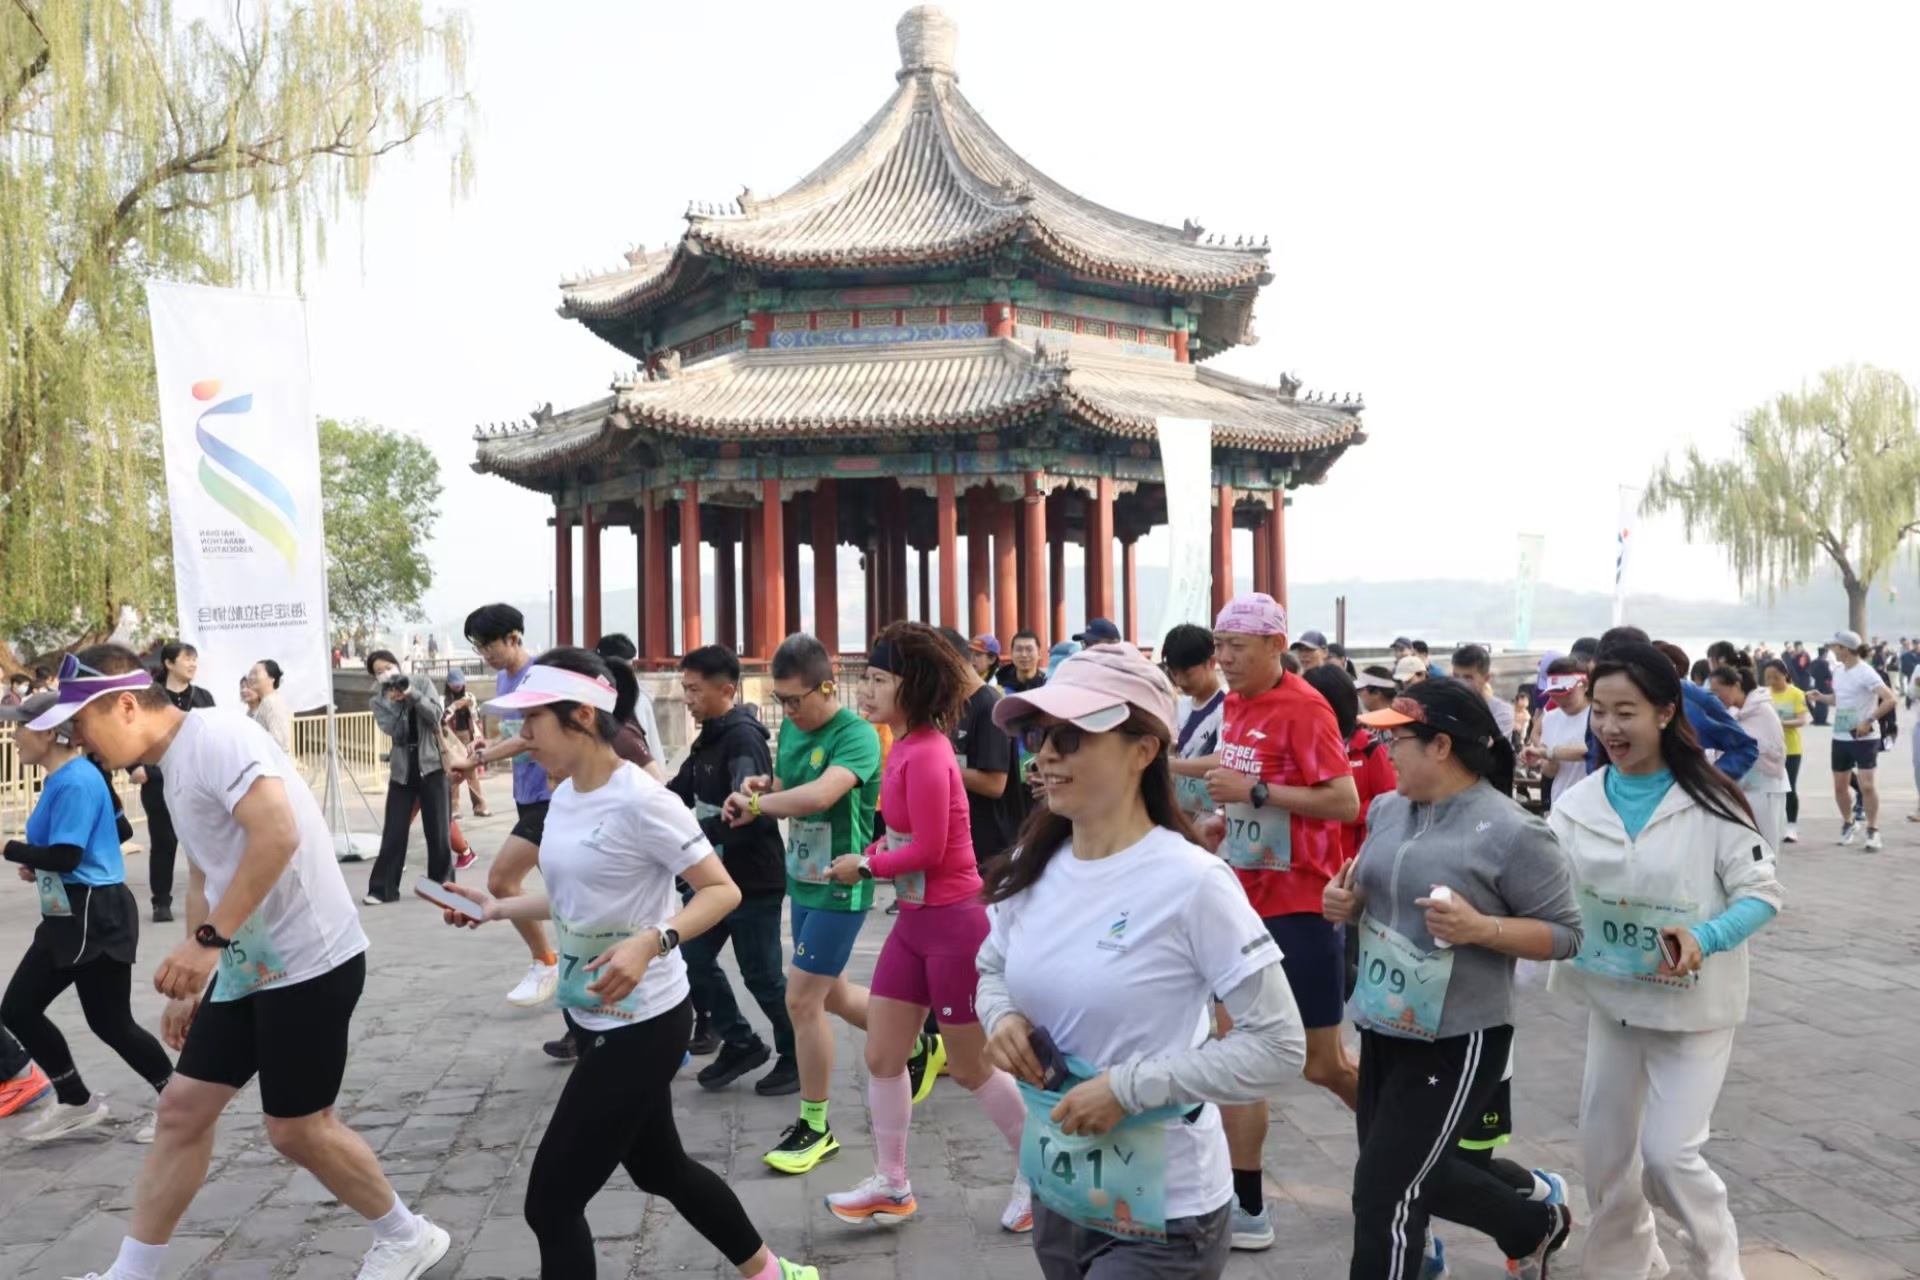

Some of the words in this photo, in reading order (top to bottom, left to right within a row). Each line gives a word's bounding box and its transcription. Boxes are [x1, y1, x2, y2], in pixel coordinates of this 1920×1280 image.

[1221, 742, 1239, 767] 京
[1237, 745, 1256, 760] BEI
[1234, 758, 1264, 774] JING
[1603, 920, 1658, 951] 083
